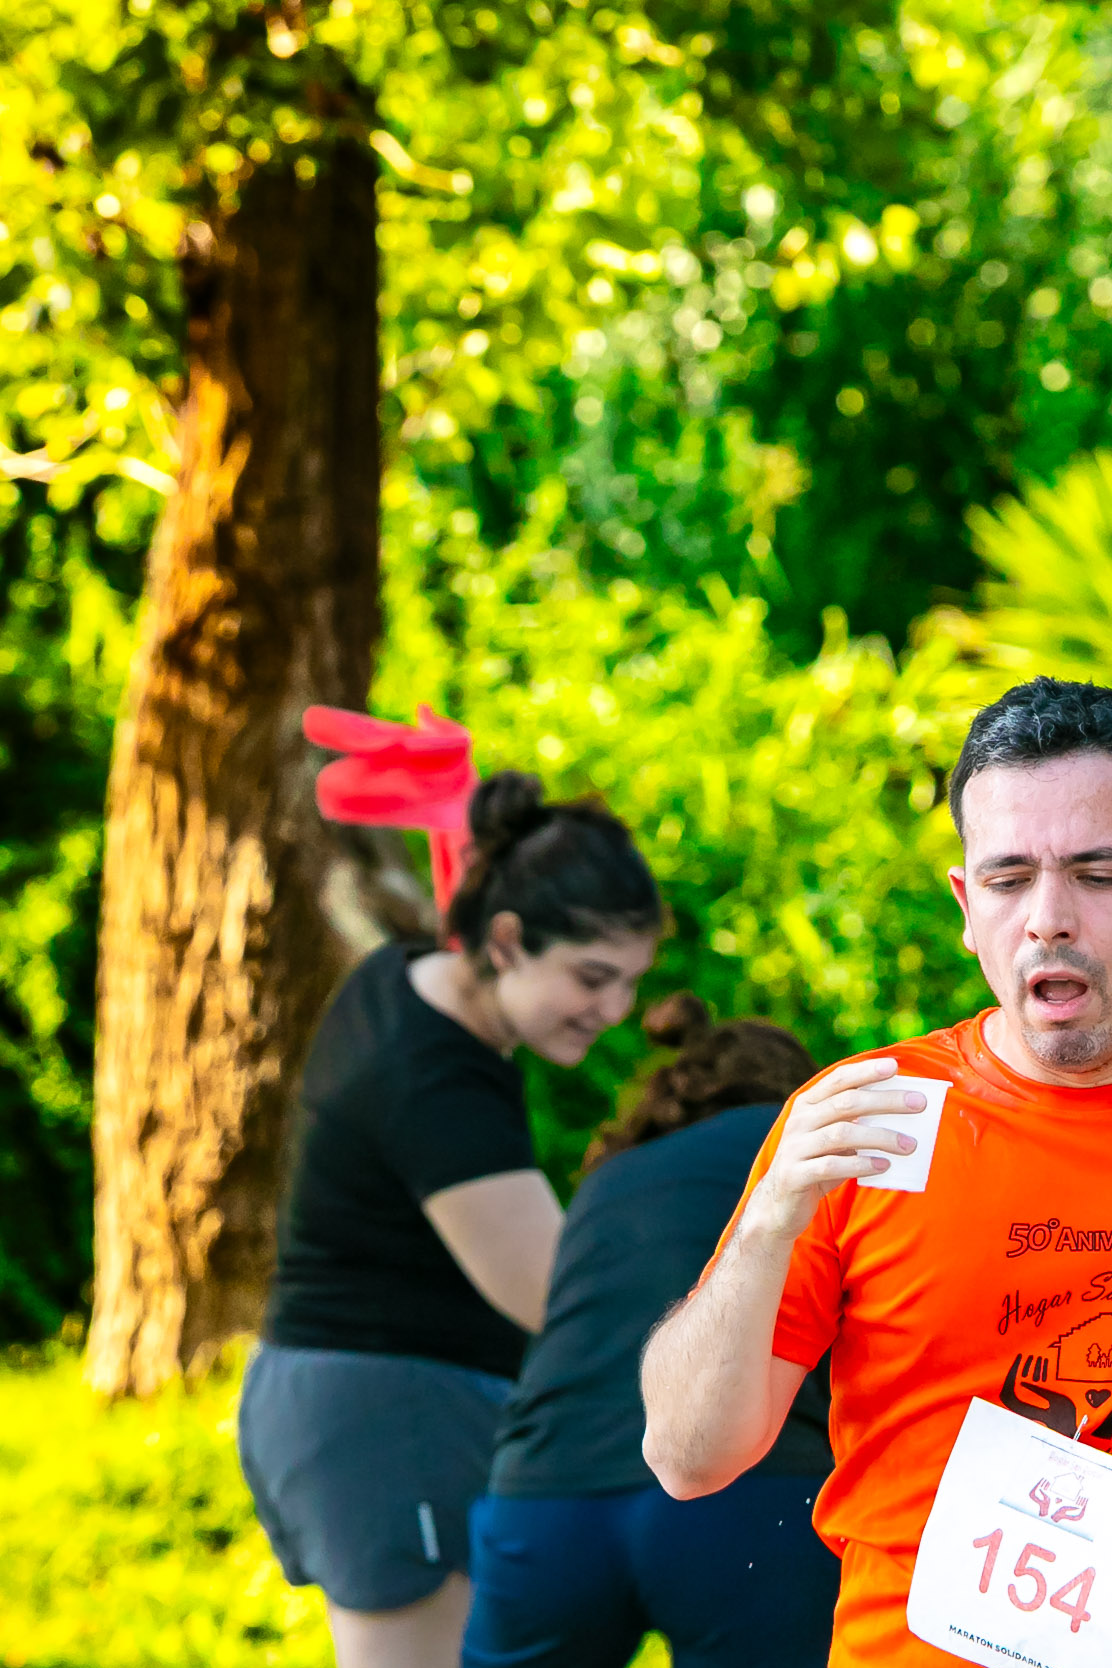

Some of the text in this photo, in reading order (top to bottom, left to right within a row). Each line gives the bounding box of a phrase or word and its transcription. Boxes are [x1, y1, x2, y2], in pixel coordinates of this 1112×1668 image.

[998, 1289, 1072, 1336] Hogar
[972, 1528, 1096, 1633] 154
[949, 1624, 993, 1649] MARATON
